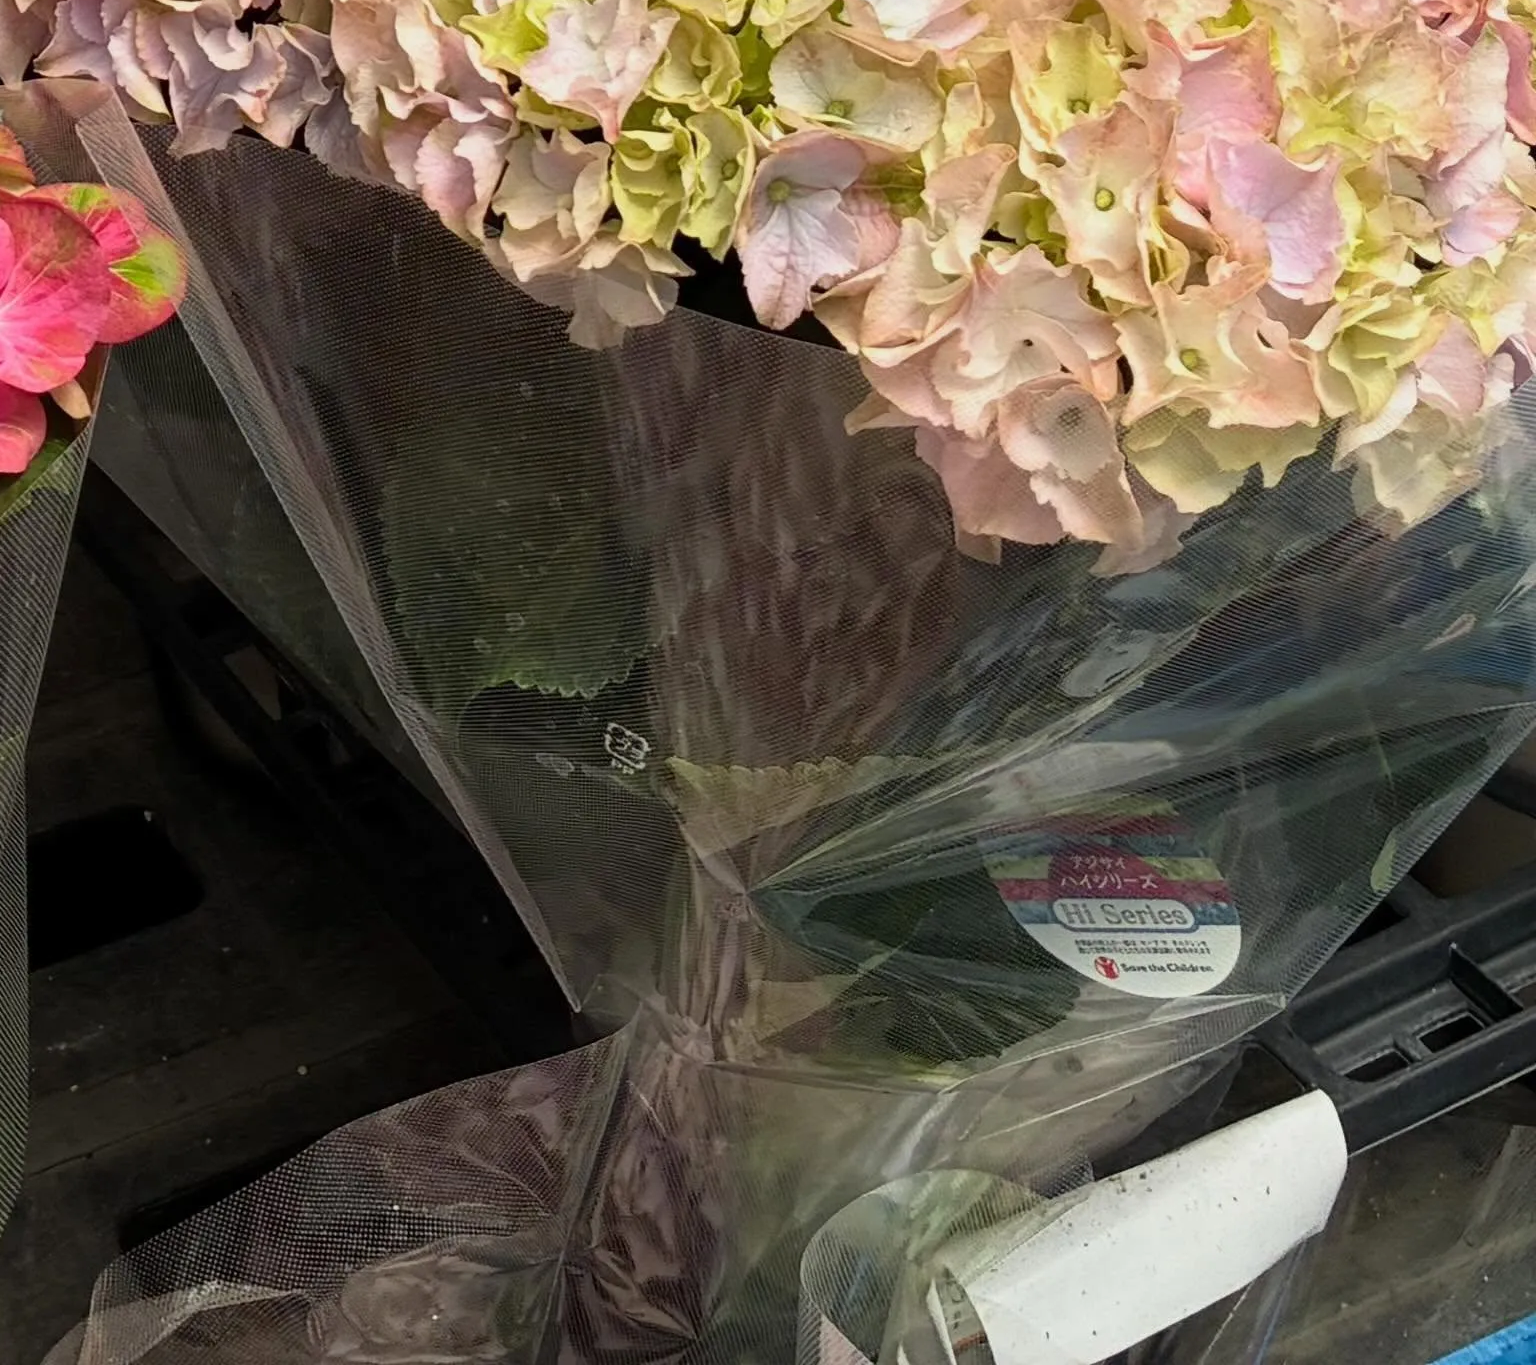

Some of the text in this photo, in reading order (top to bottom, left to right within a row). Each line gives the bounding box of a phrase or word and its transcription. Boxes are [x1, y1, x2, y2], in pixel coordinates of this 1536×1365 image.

[1057, 901, 1188, 926] Hi Series
[1120, 962, 1147, 974] Save
[1148, 962, 1166, 974] the
